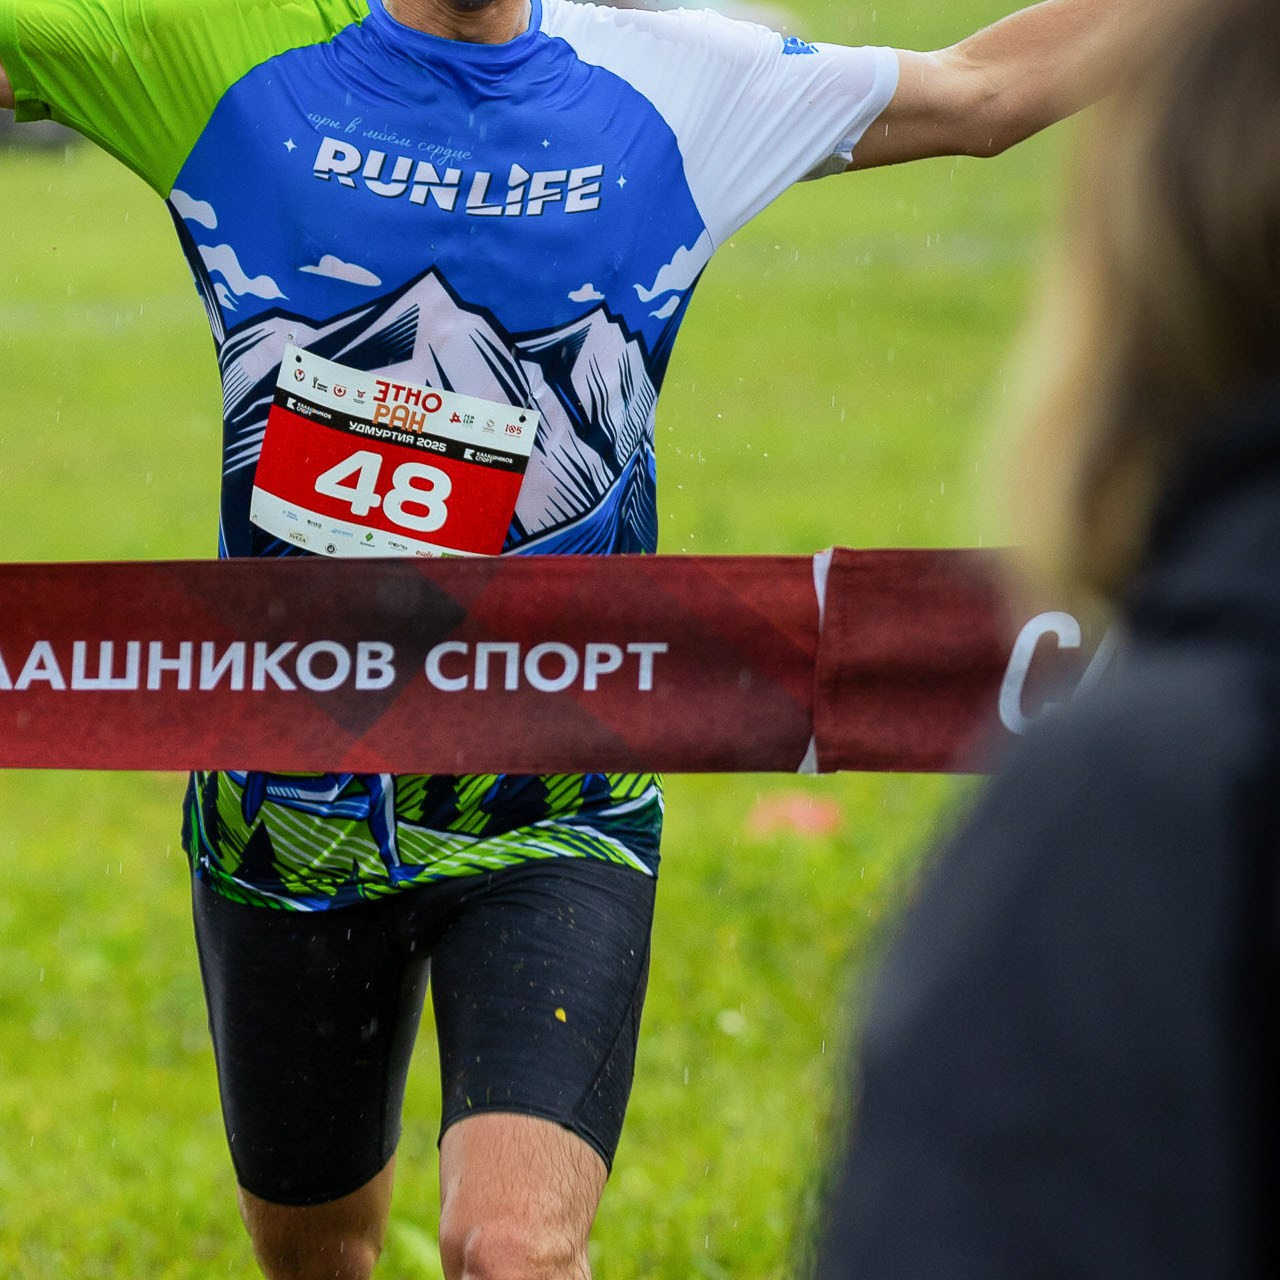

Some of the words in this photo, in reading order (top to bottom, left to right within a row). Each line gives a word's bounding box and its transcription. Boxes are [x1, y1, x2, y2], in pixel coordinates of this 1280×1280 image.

[345, 117, 362, 134] в
[417, 142, 472, 166] сердце
[373, 379, 443, 414] ЭТНО
[349, 420, 415, 444] УДМУРТИЯ
[416, 437, 448, 453] 2025
[372, 403, 427, 435] РАН
[314, 449, 453, 533] 48
[423, 641, 669, 693] СПОРТ
